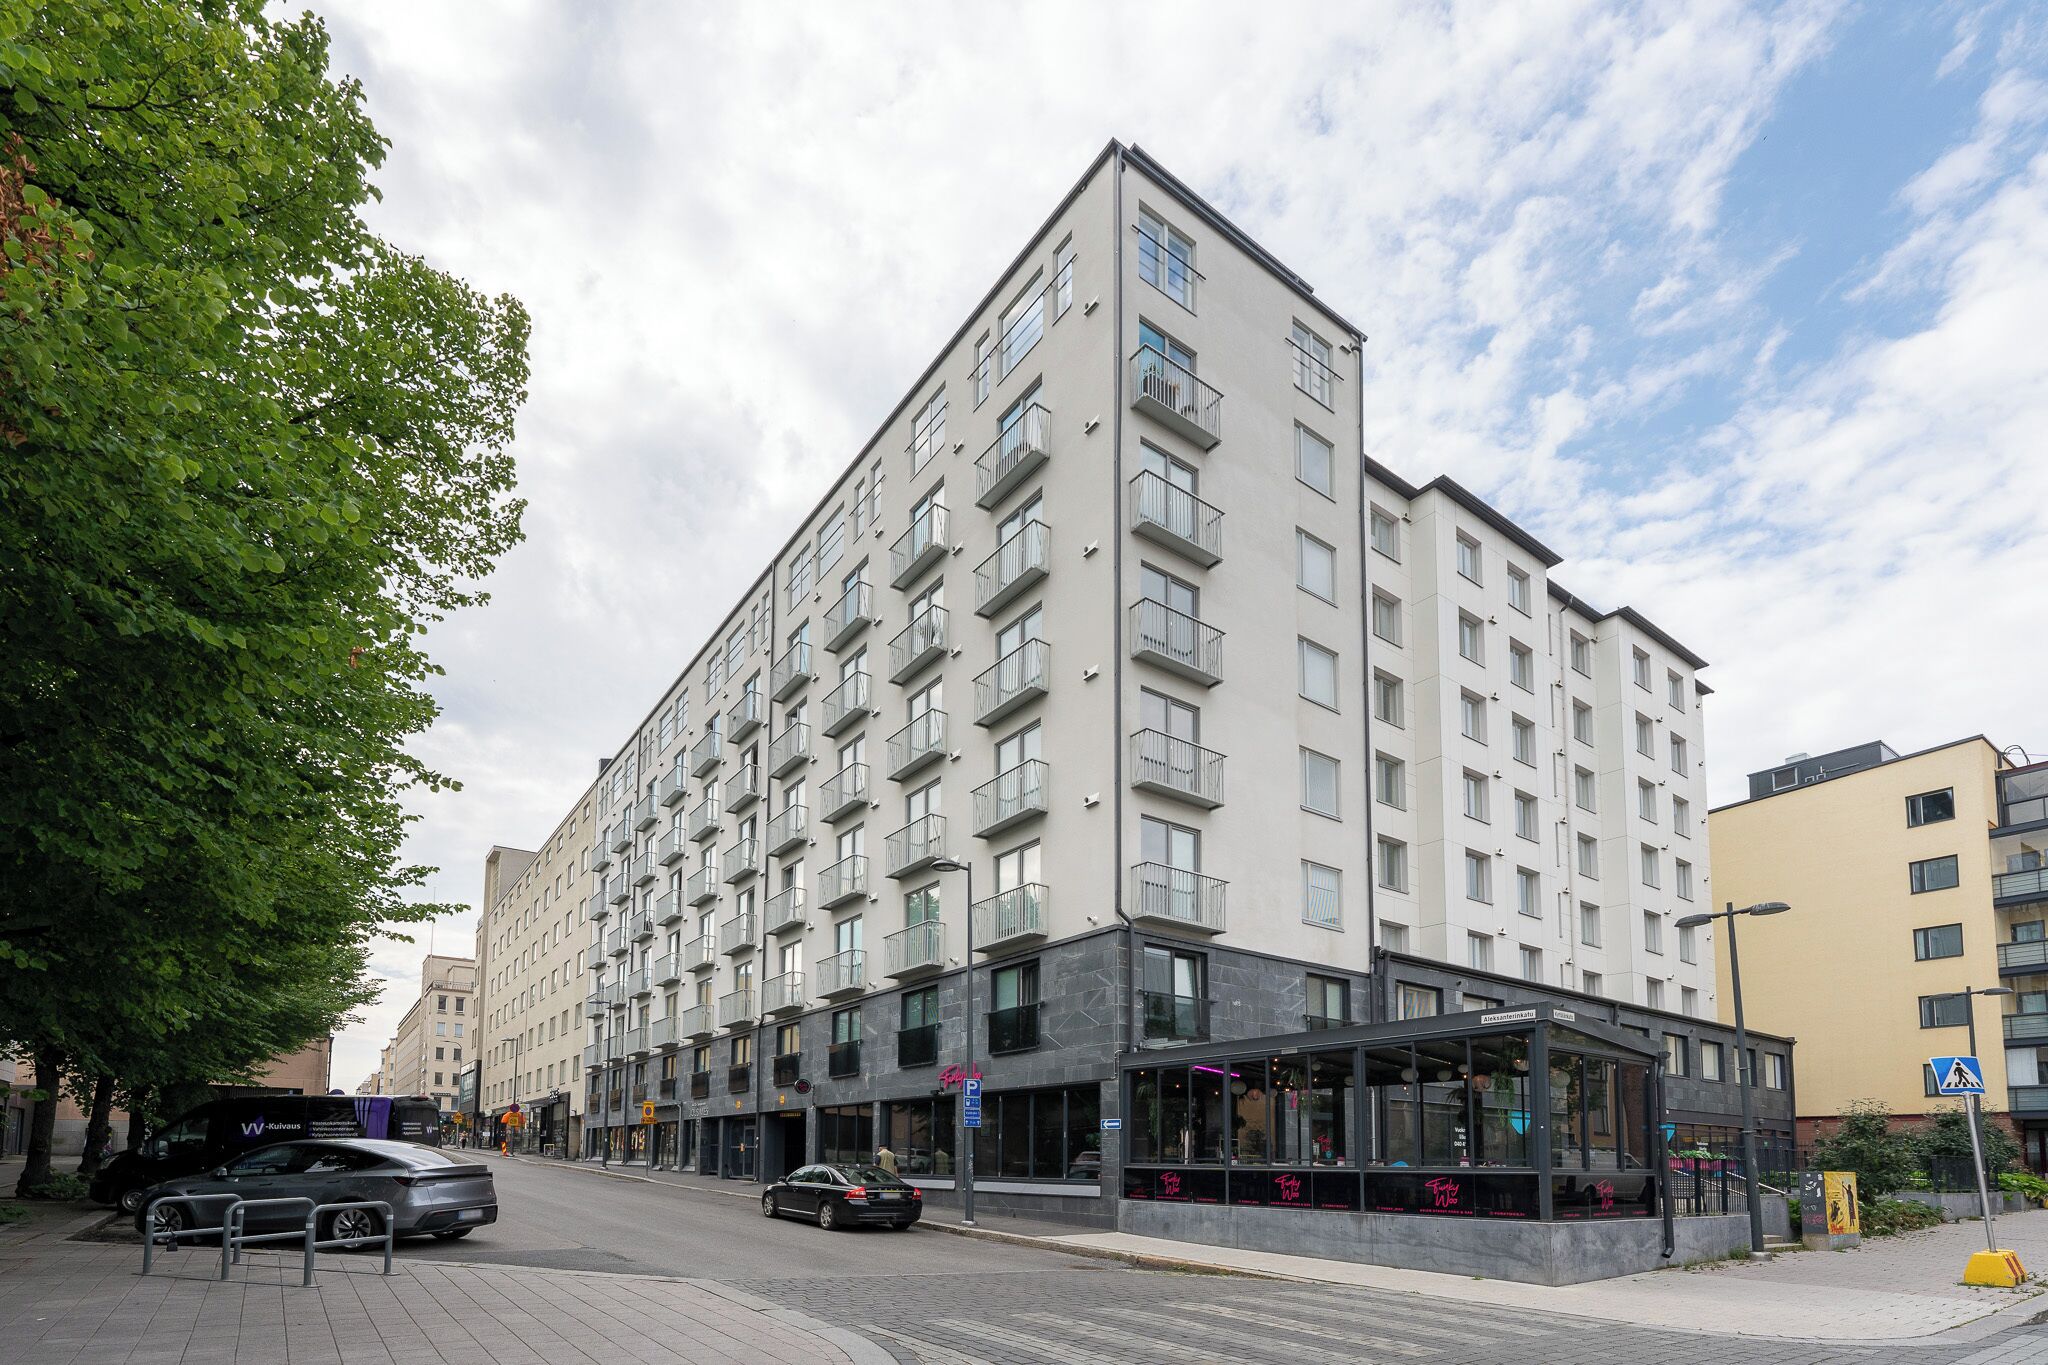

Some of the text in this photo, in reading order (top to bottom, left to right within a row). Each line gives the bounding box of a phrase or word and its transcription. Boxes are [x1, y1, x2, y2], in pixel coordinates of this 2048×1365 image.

[1483, 1011, 1534, 1022] Aleksanterinkatu
[966, 1080, 978, 1096] P
[1160, 1171, 1181, 1187] Funky
[1275, 1174, 1301, 1191] Funky
[1424, 1177, 1460, 1197] Funky
[1165, 1181, 1180, 1195] Woo
[1282, 1185, 1299, 1200] Woo
[1436, 1189, 1458, 1208] Woo
